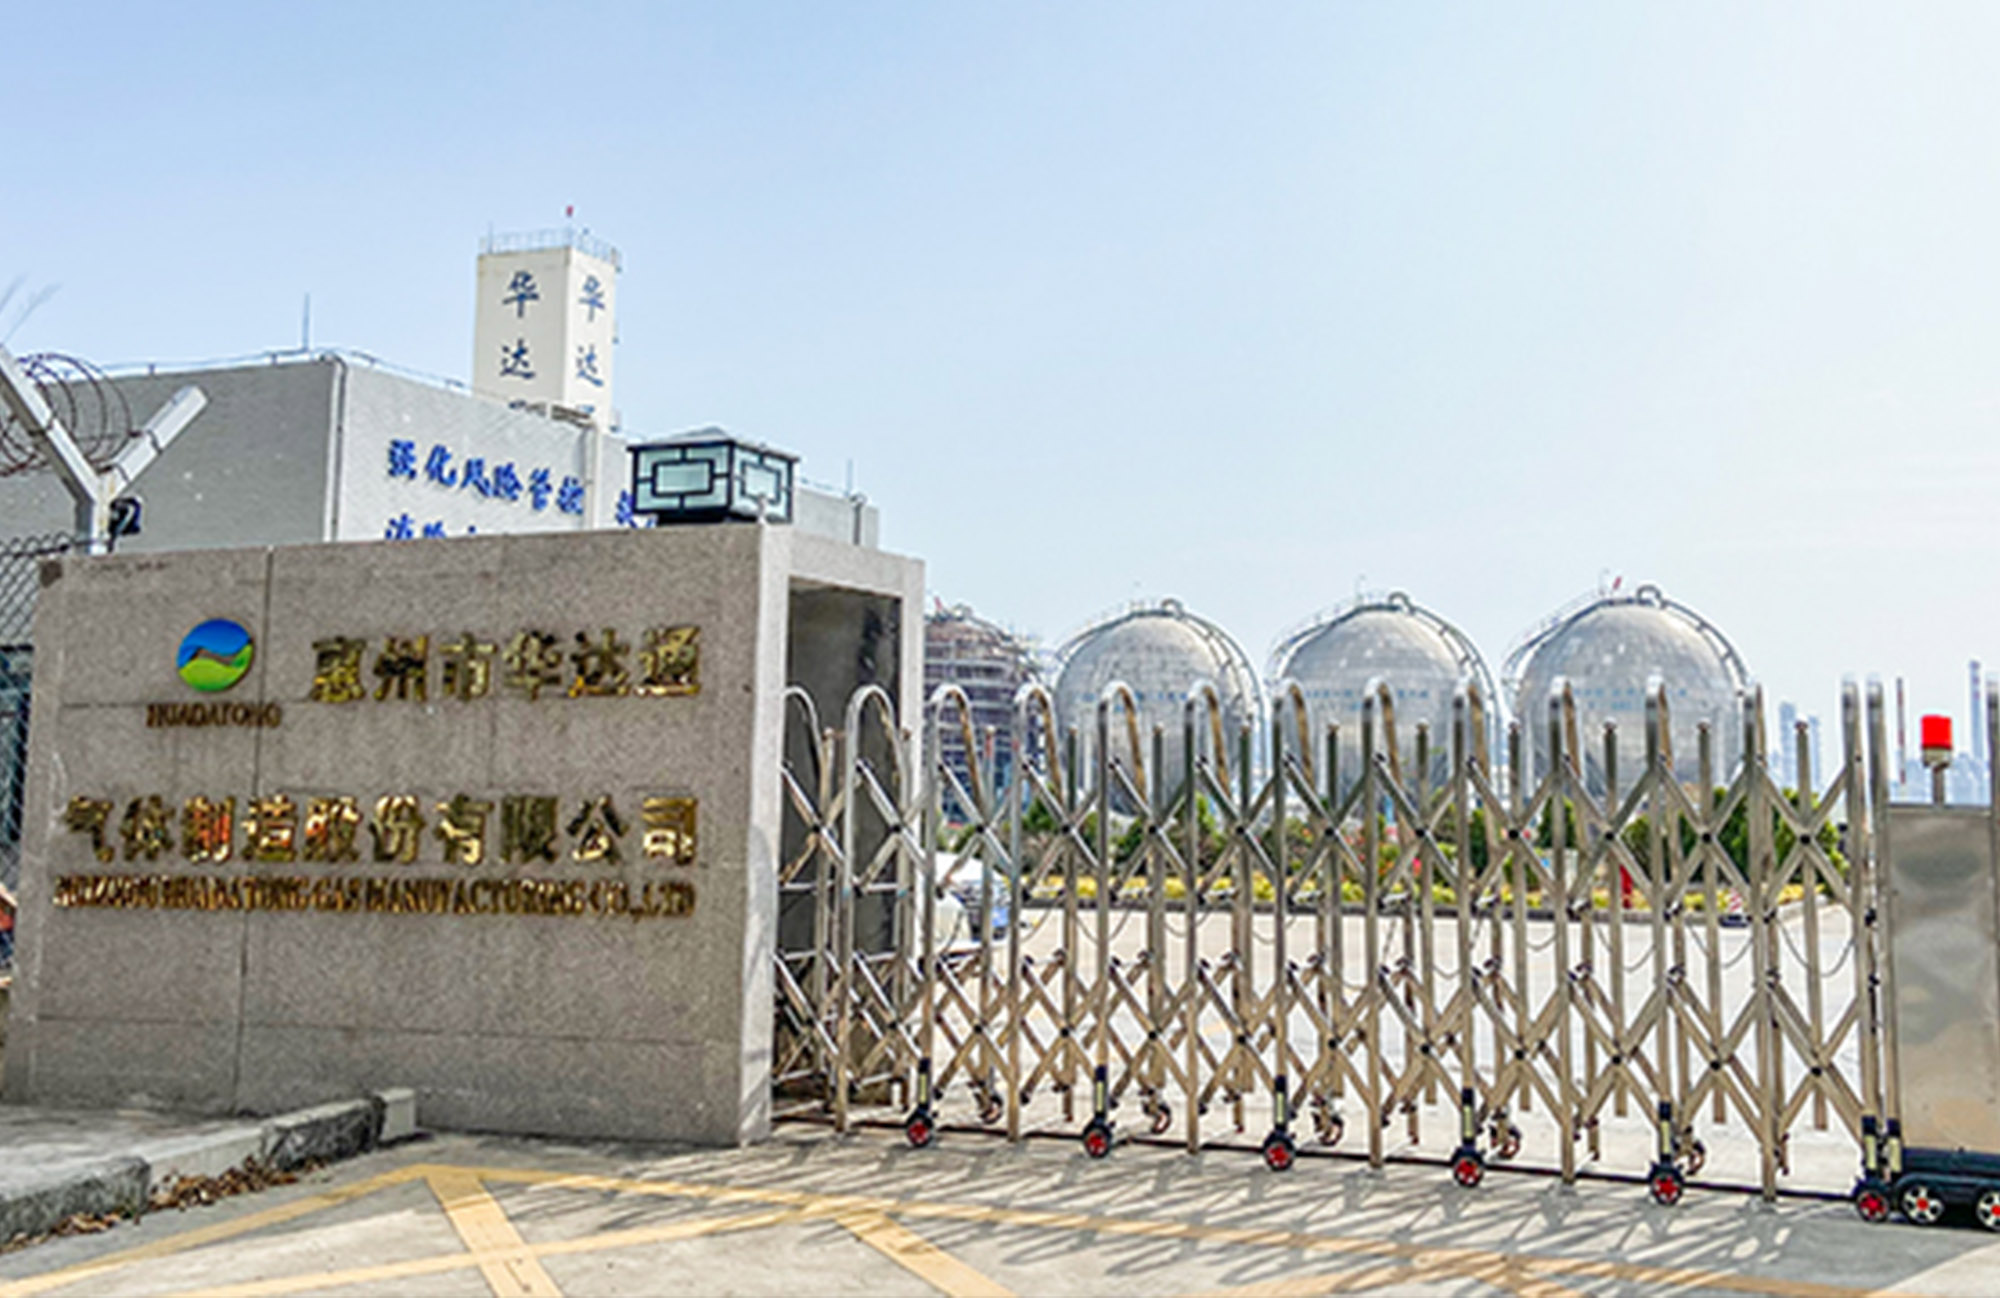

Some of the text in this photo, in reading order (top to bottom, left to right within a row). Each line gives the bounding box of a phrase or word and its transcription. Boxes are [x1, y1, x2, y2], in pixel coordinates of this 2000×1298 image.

[499, 269, 541, 410] 华达
[576, 274, 607, 414] 华达
[311, 627, 700, 702] 惠州市华达通
[146, 702, 281, 728] HUADATONG
[64, 795, 698, 865] 气体制造股份有限公司
